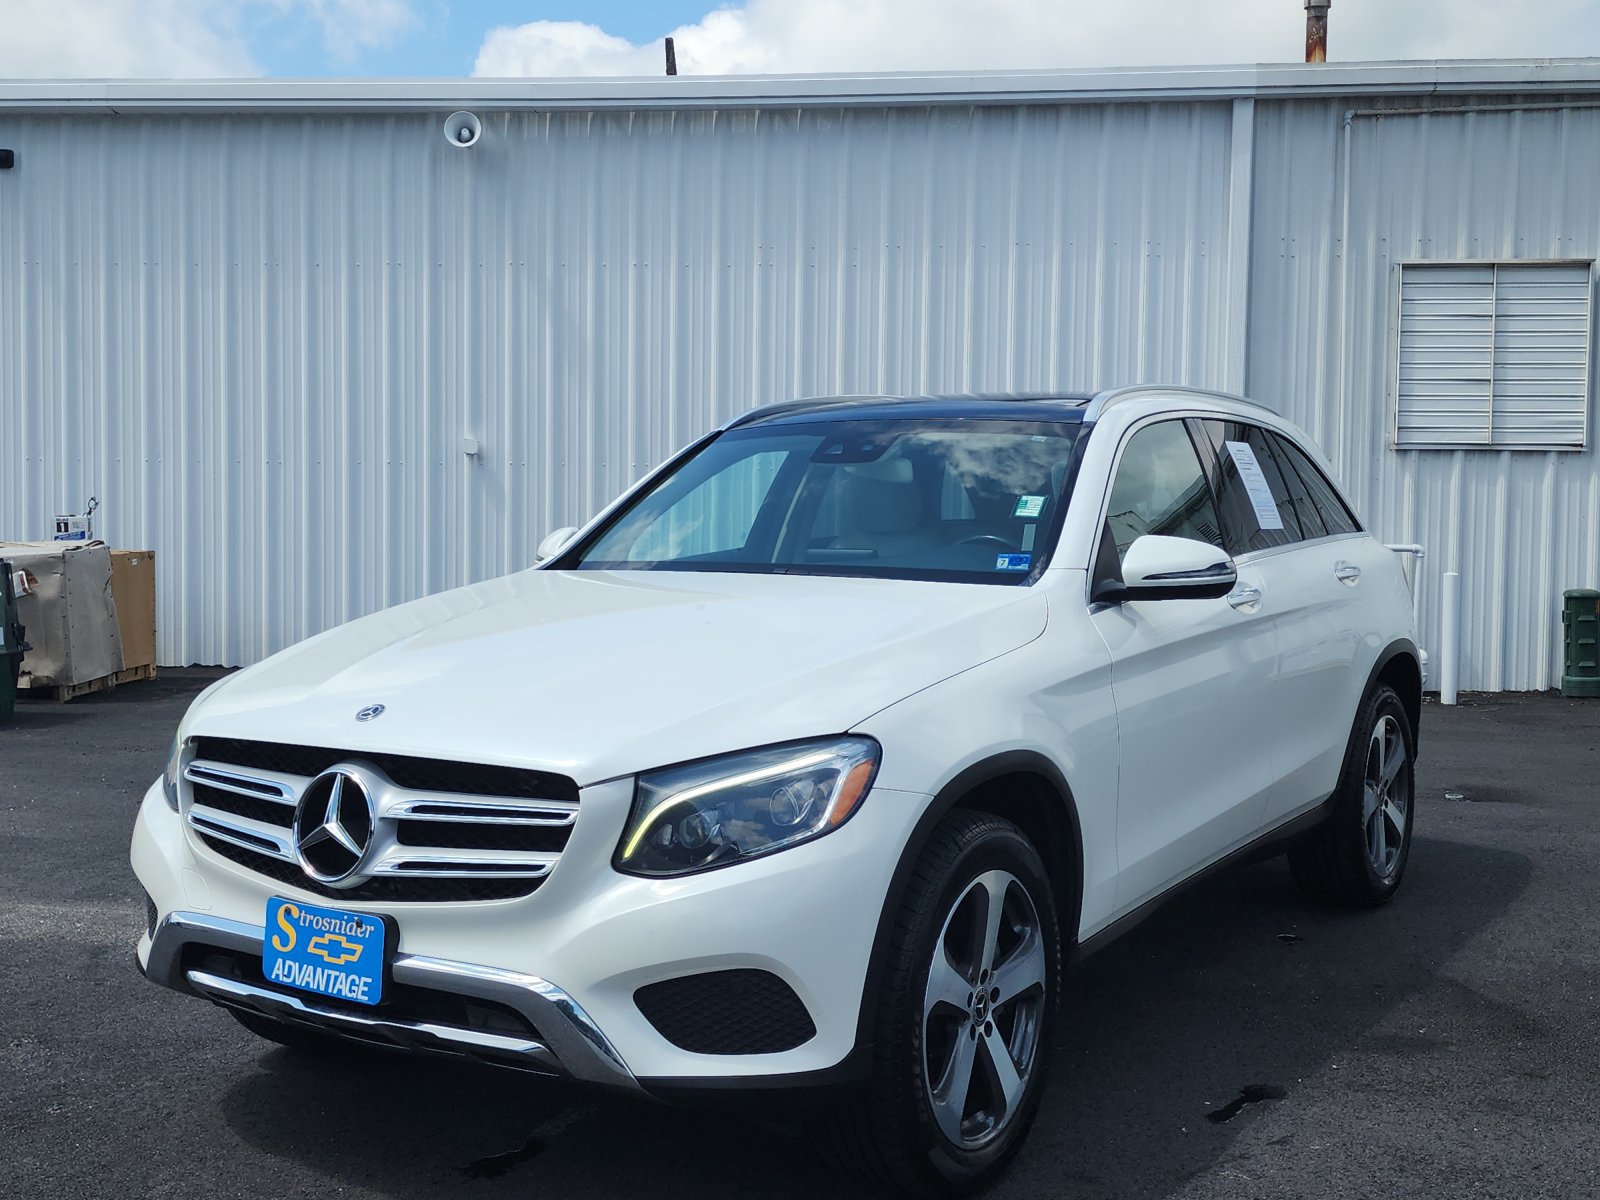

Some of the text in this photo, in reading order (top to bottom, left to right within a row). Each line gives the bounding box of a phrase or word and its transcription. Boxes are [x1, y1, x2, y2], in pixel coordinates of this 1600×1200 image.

[1000, 559, 1006, 567] 7
[272, 904, 374, 952] Strosnider
[271, 958, 372, 1000] ADVANTAGE
